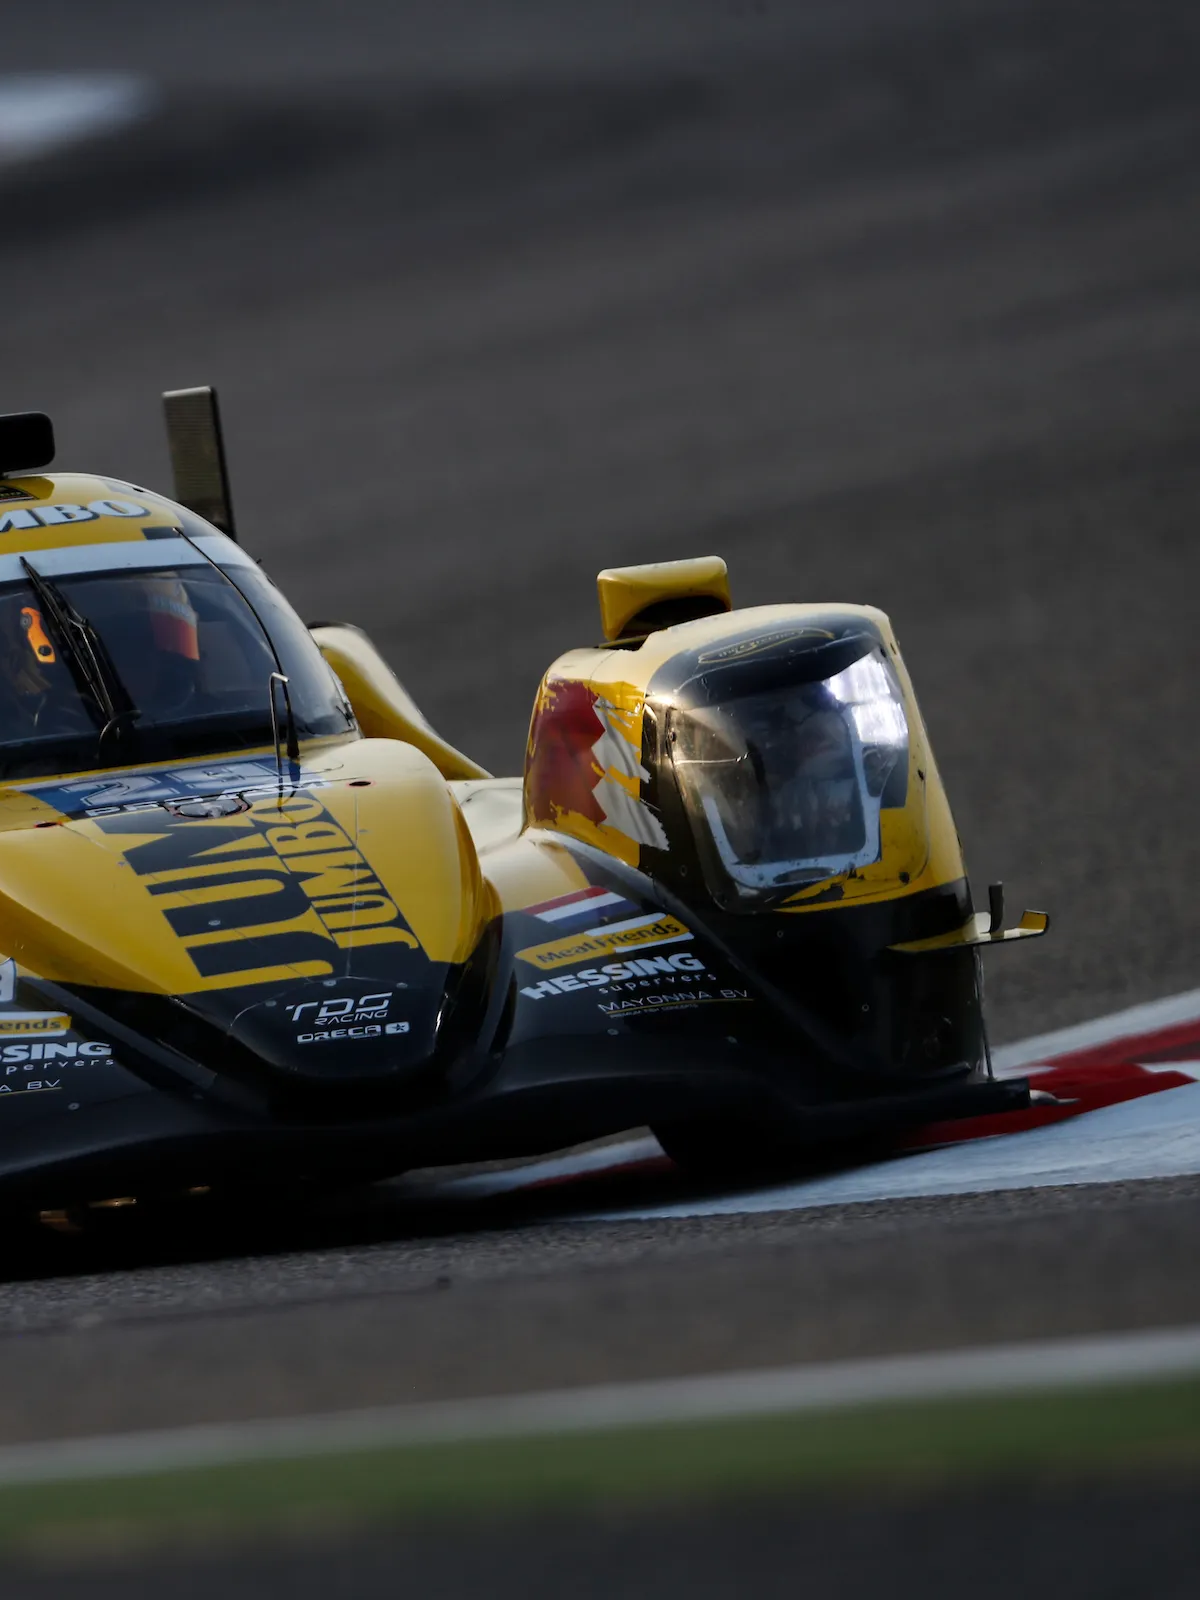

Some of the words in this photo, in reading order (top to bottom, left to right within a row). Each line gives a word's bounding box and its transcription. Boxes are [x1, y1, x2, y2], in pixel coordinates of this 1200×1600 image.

[250, 796, 419, 949] JUMBO
[519, 953, 705, 1000] HESSING
[599, 973, 716, 995] supervers
[285, 992, 393, 1021] TDS
[598, 991, 712, 1013] MAYONNA
[720, 989, 748, 999] BV
[314, 1010, 388, 1026] RACING
[297, 1025, 381, 1043] ORECA
[27, 1079, 61, 1090] BV
